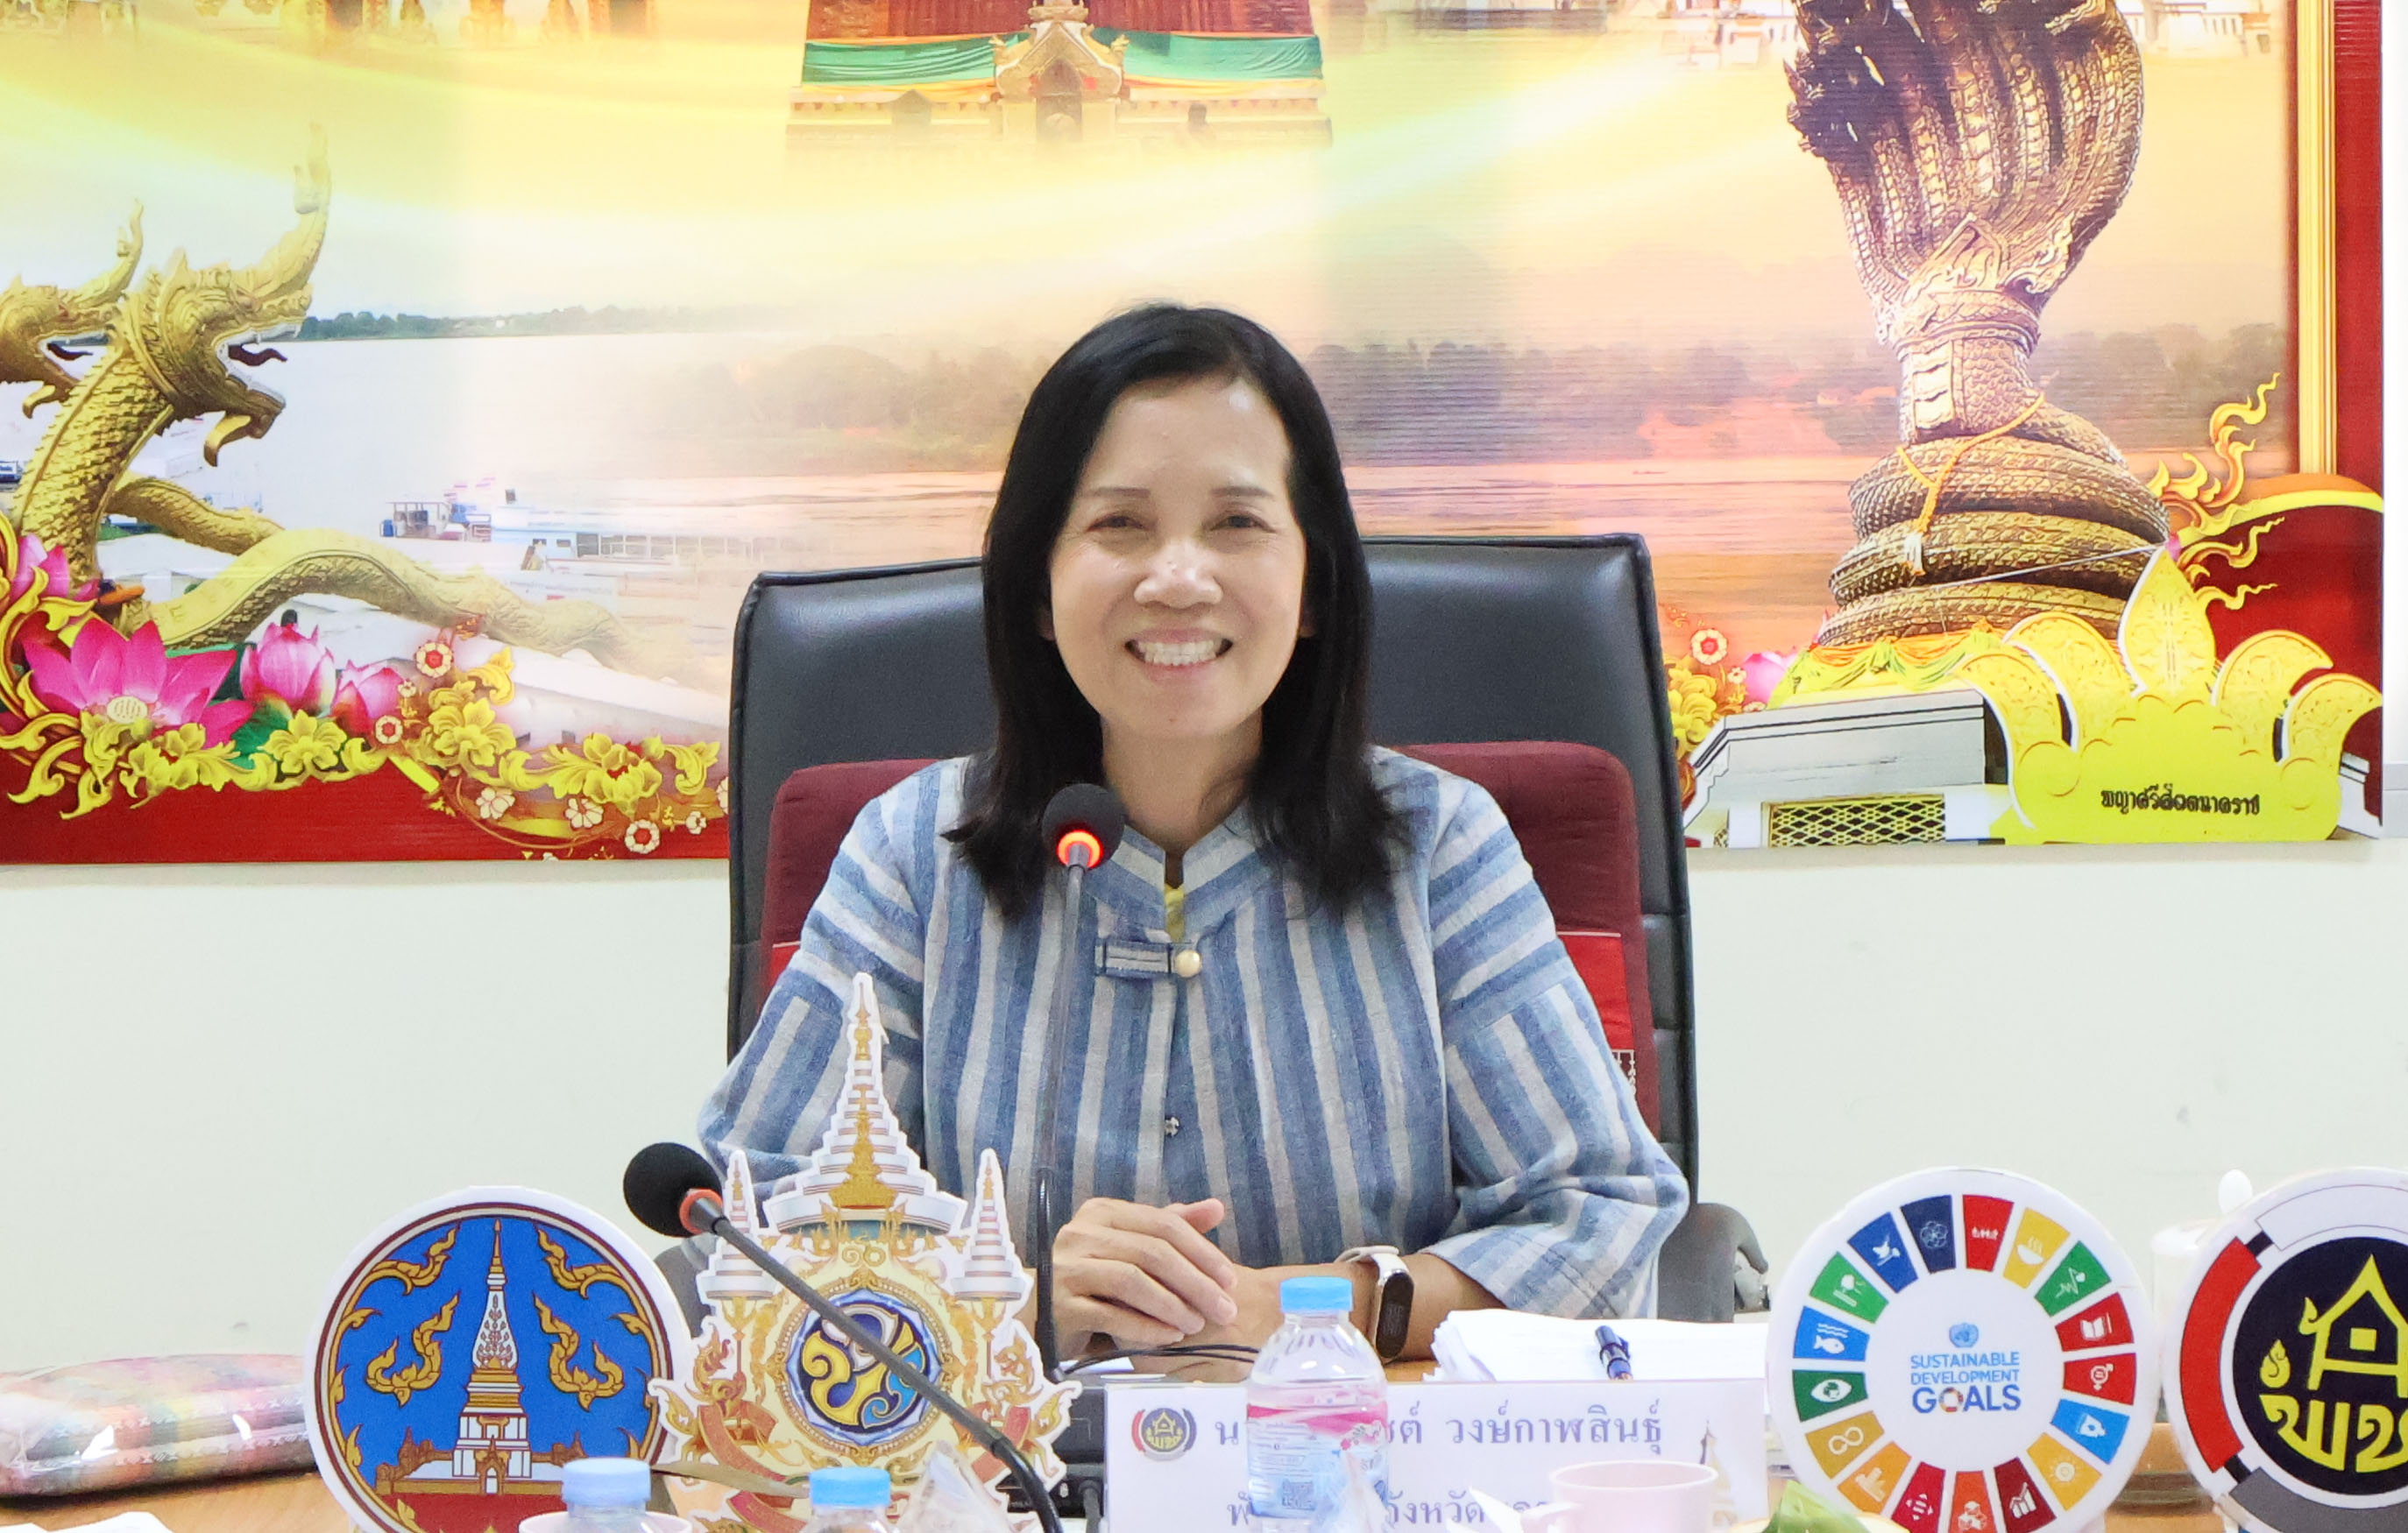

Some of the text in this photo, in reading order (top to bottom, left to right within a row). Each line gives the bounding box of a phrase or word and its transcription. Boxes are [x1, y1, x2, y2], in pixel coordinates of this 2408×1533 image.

[1910, 1352, 2020, 1369] SUSTAINABLE
[1910, 1369, 2020, 1385] DEVELOPMENT
[1912, 1384, 2022, 1414] GOALS
